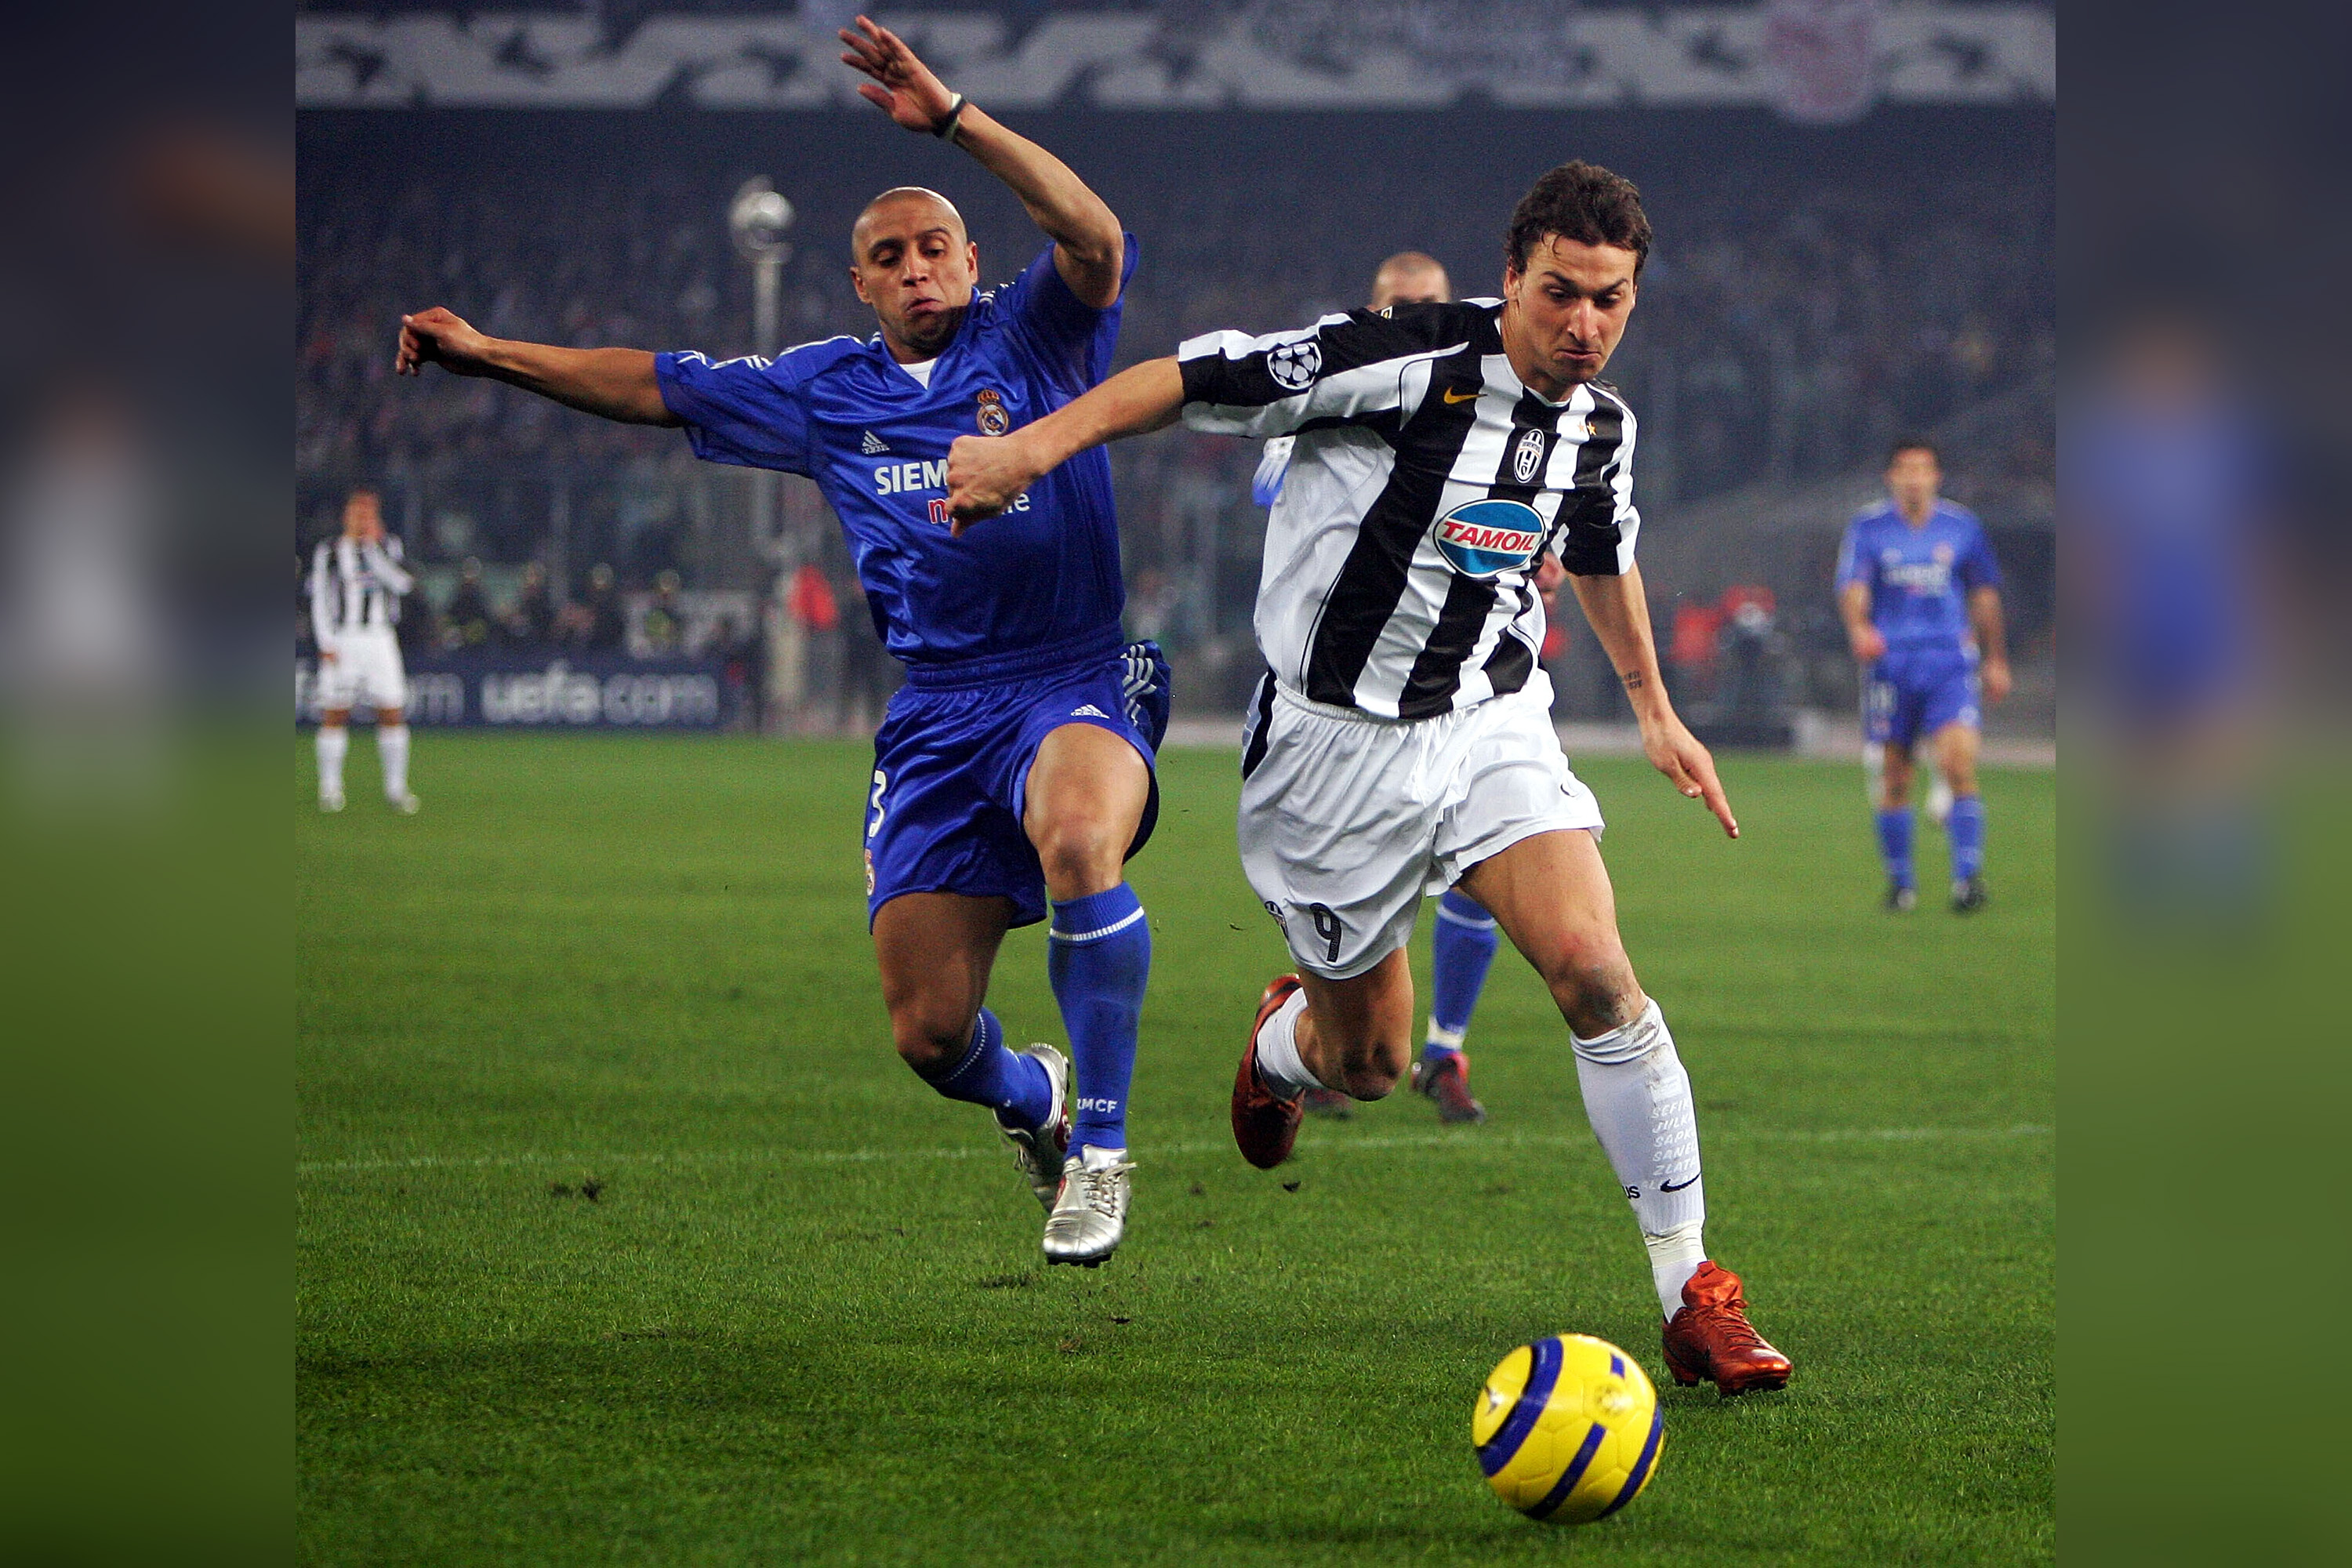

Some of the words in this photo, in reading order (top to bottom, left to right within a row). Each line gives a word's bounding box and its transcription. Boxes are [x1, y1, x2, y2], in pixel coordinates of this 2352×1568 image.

[874, 459, 949, 495] SIEM
[1442, 521, 1536, 551] TAMOIL
[869, 769, 887, 837] 3
[1308, 902, 1342, 963] 9
